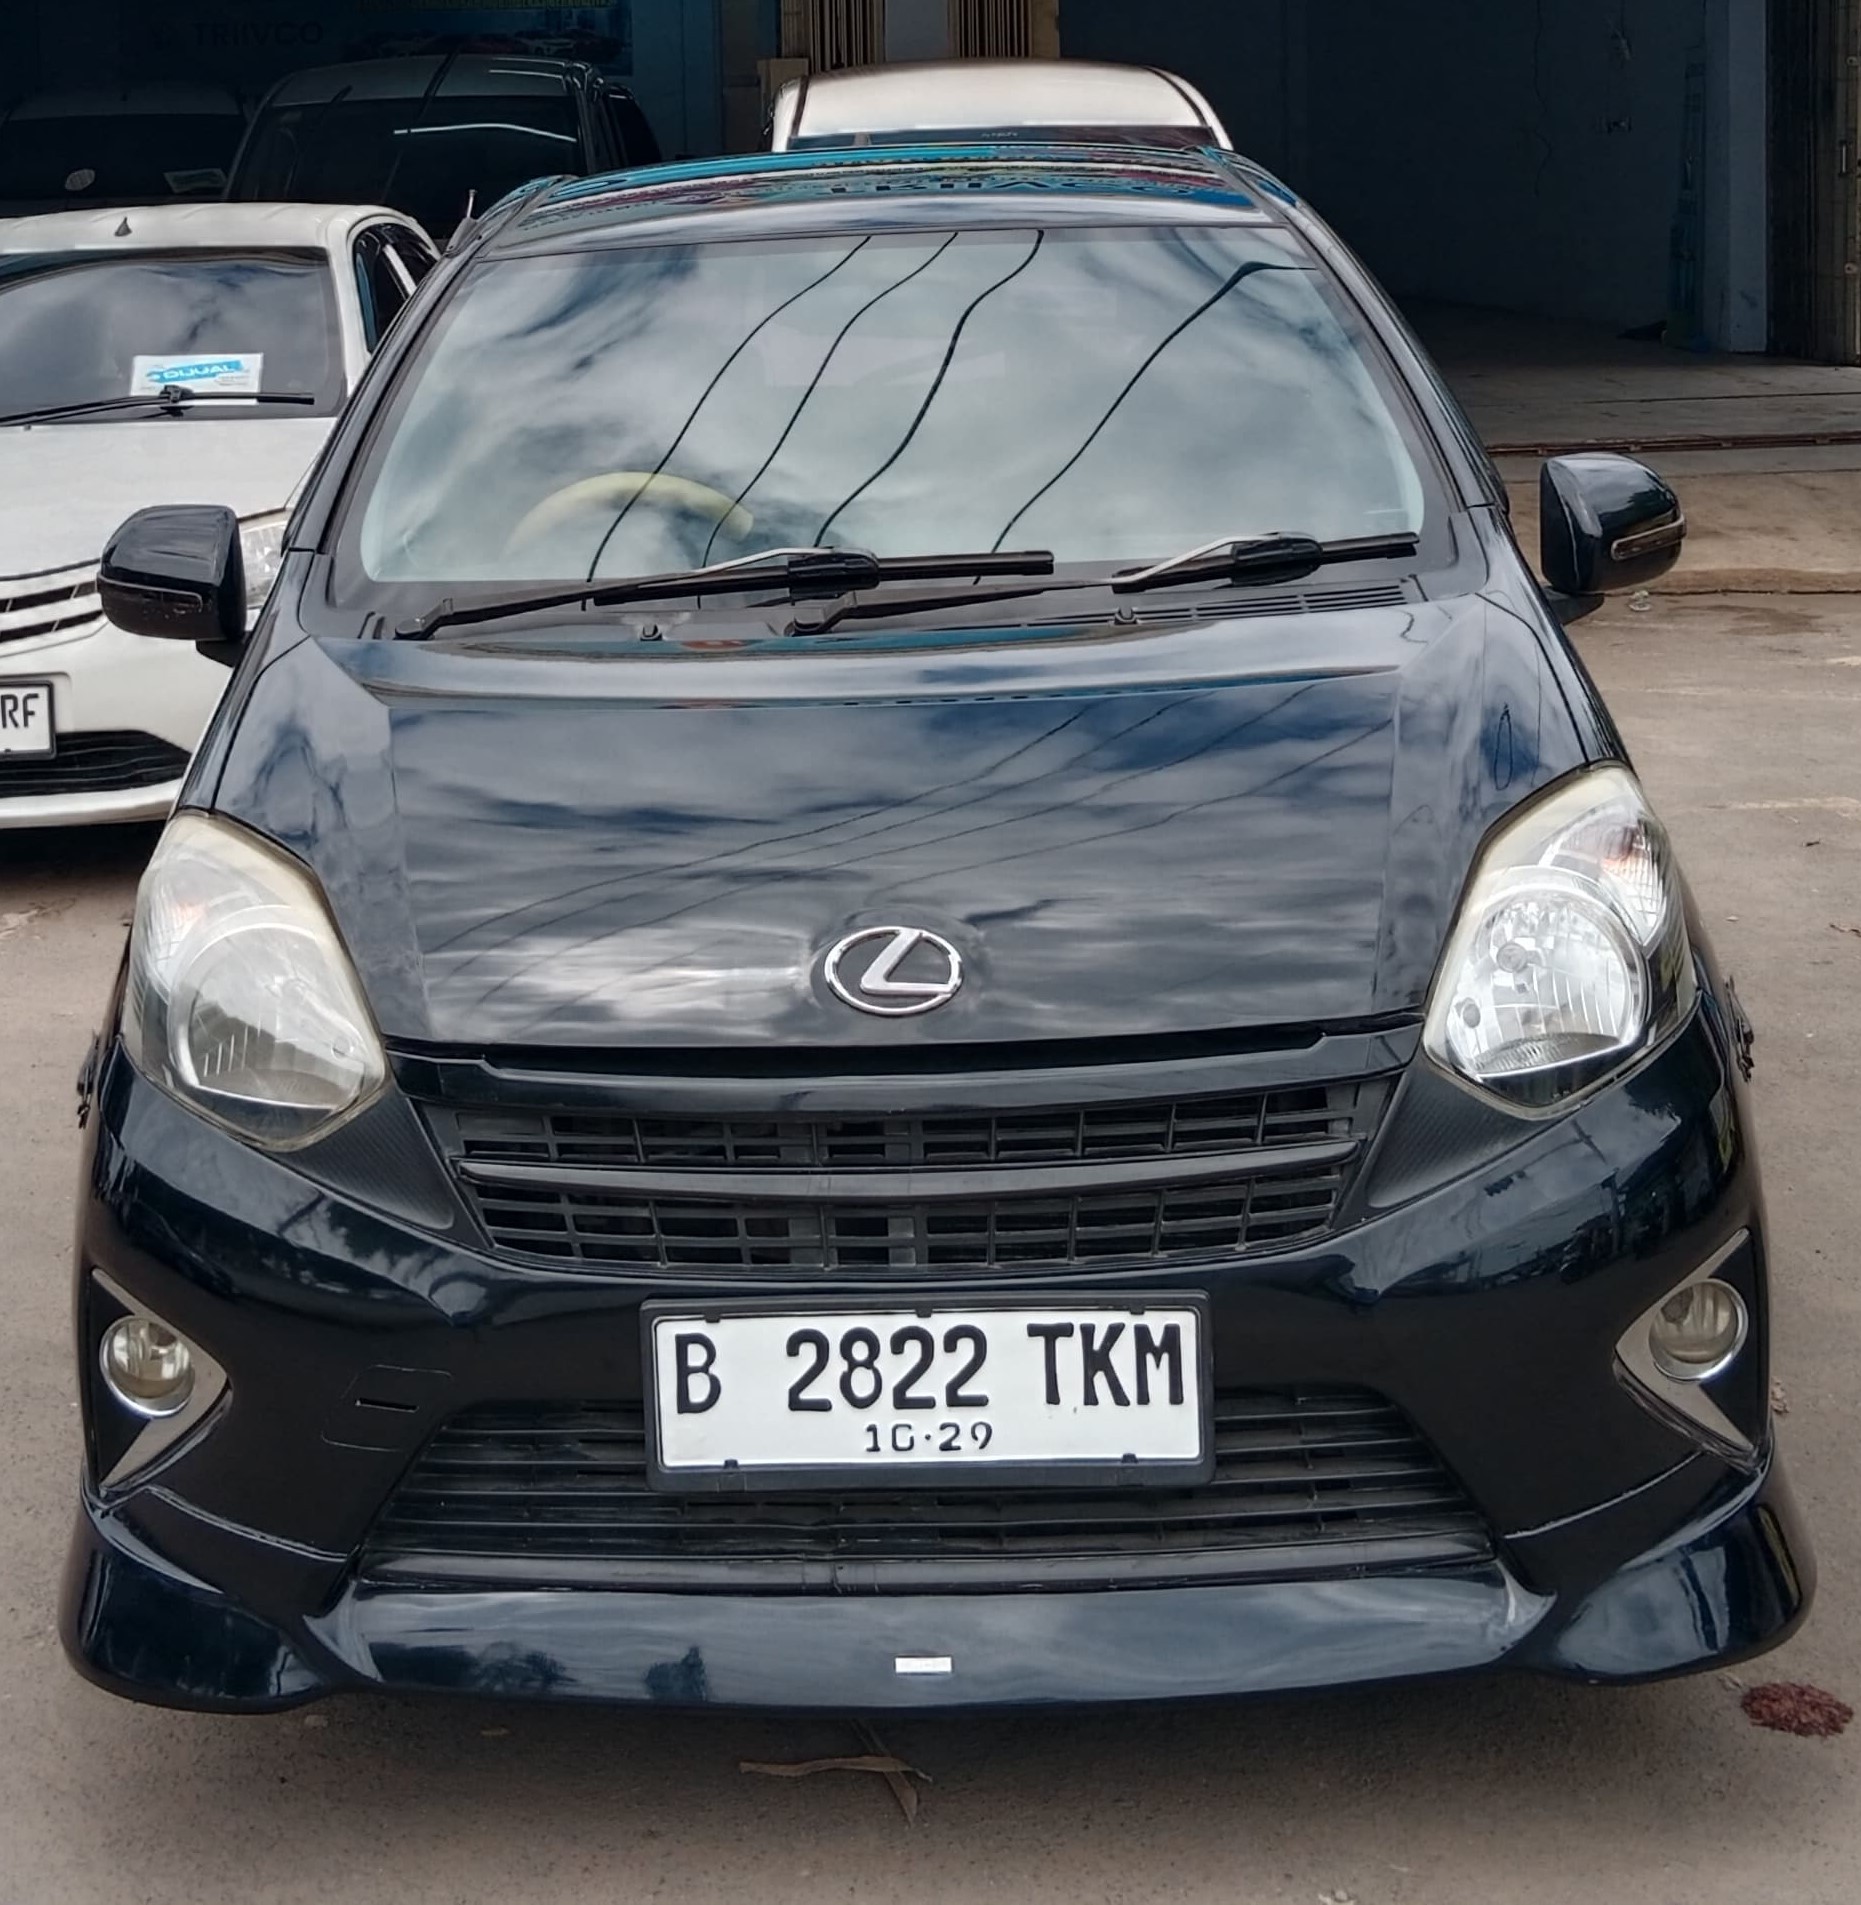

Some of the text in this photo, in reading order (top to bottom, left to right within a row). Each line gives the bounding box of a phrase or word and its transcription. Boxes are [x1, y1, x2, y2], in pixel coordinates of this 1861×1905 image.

[0, 693, 40, 729] RF
[674, 1321, 1185, 1415] B 2822 TKM
